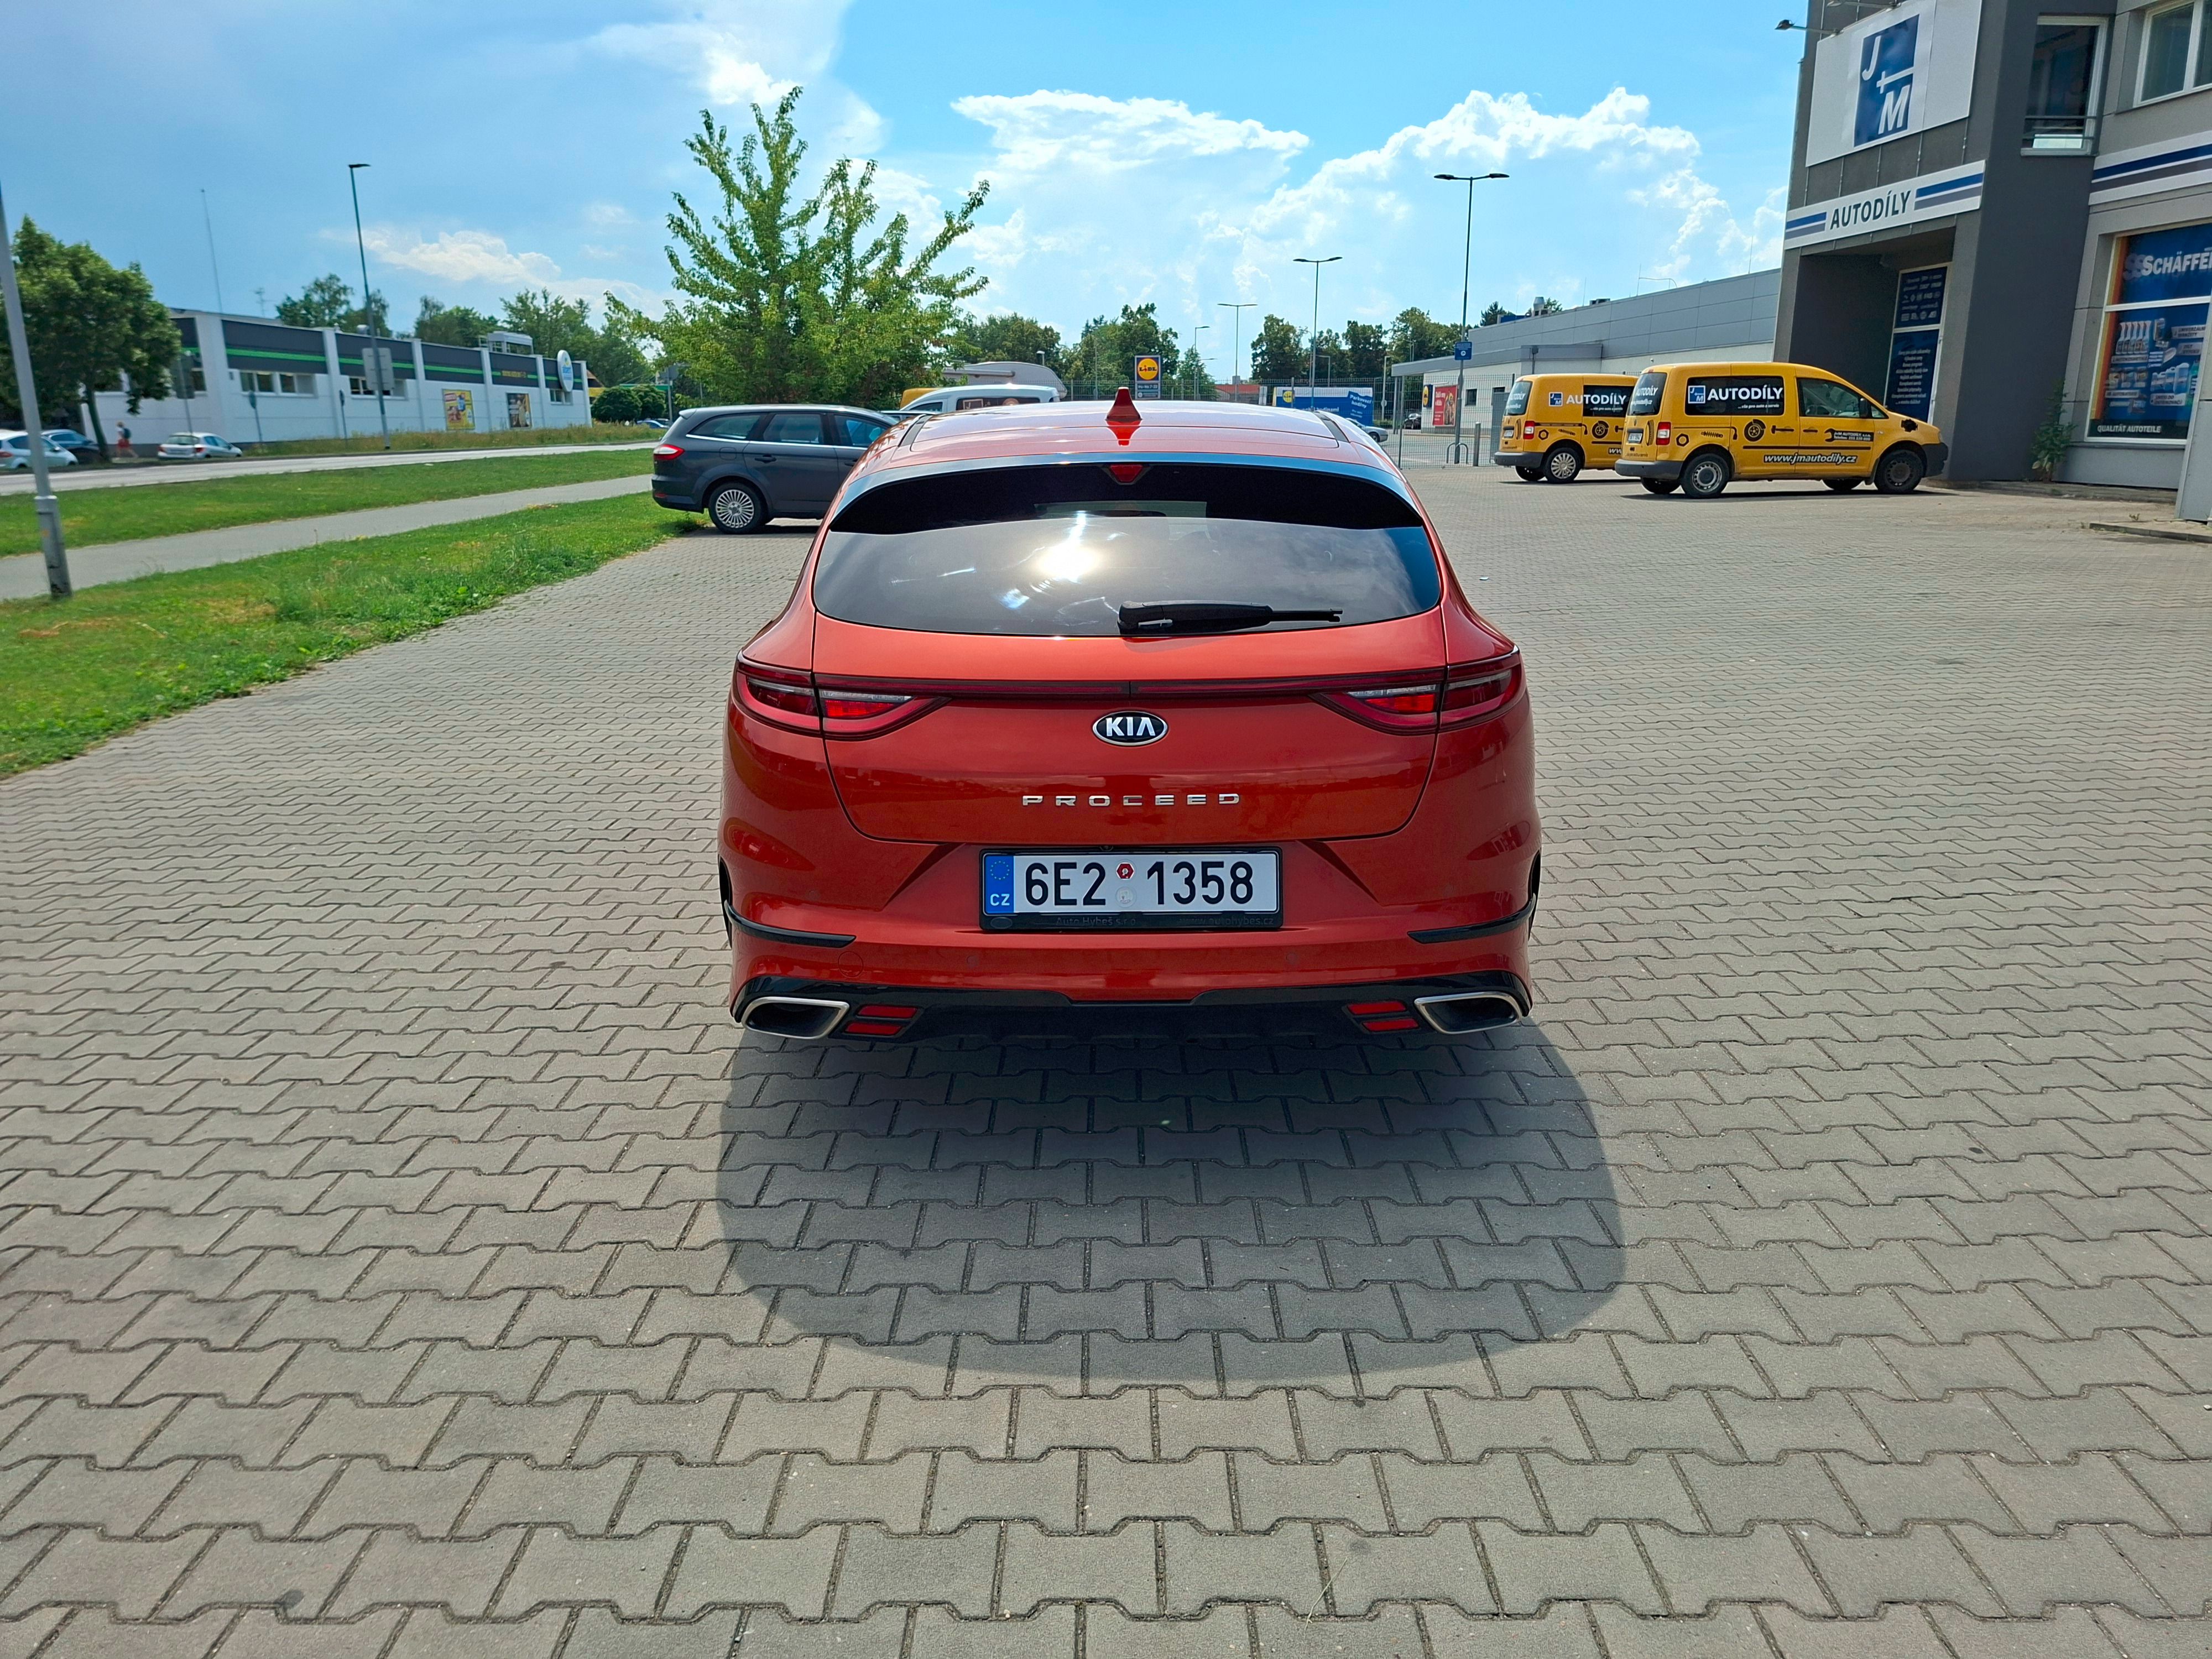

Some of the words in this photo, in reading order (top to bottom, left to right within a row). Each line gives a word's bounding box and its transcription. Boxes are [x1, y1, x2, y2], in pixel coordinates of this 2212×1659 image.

[1830, 190, 1911, 230] AUTODÍLY
[2141, 248, 2212, 276] SCHÄFFE
[1566, 393, 1627, 405] AUTODÍLY
[1707, 384, 1783, 401] AUTODÍLY
[2097, 424, 2126, 432] QUALITÄT
[1765, 452, 1856, 464] www.jmautodily.cz
[1106, 717, 1156, 737] KIA
[1021, 792, 1240, 807] PROCEED
[1025, 861, 1107, 906] 6E2
[1146, 860, 1254, 906] 1358
[990, 894, 1010, 906] CZ
[1056, 917, 1080, 926] Auto
